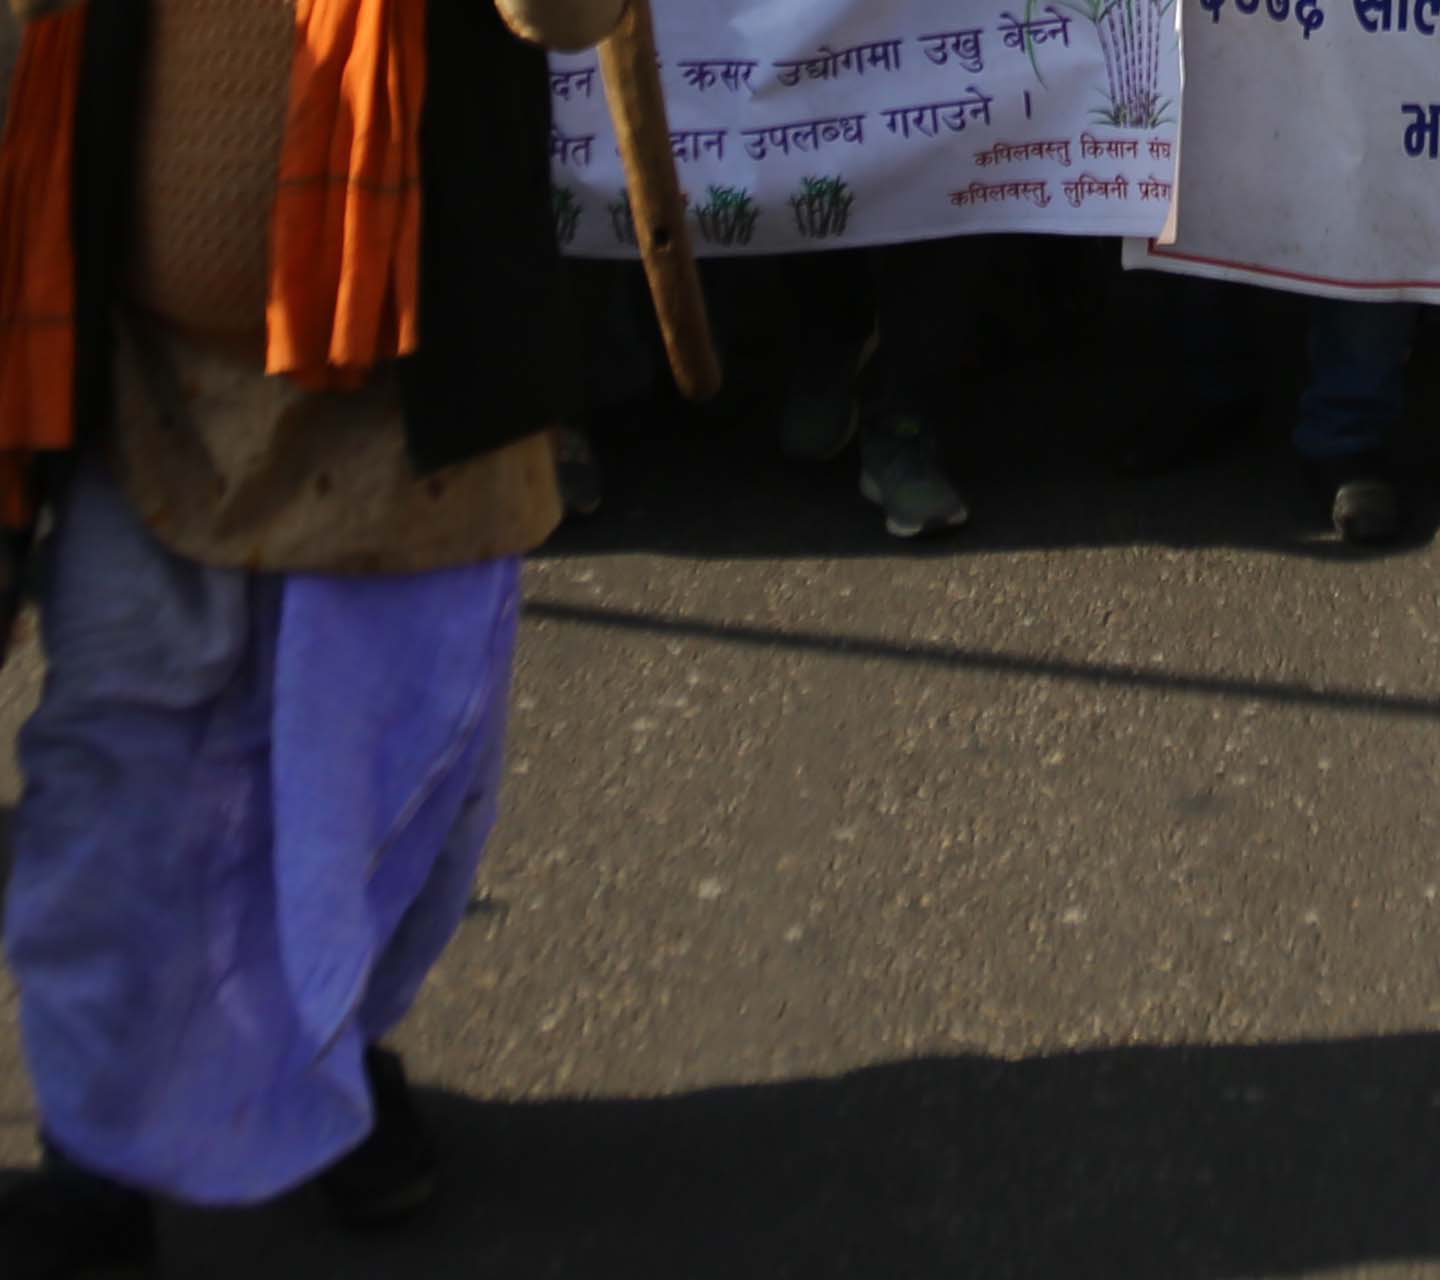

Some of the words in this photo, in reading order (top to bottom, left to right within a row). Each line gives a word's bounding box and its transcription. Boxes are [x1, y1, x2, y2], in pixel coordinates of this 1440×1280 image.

[678, 60, 757, 95] क्रसर
[918, 28, 984, 73] उखु
[997, 6, 1072, 52] बेच्ने
[741, 113, 865, 160] उपलब्ध
[881, 86, 992, 139] गराउने
[974, 139, 1072, 168] कपिलवस्तु
[1080, 133, 1138, 159] किसान
